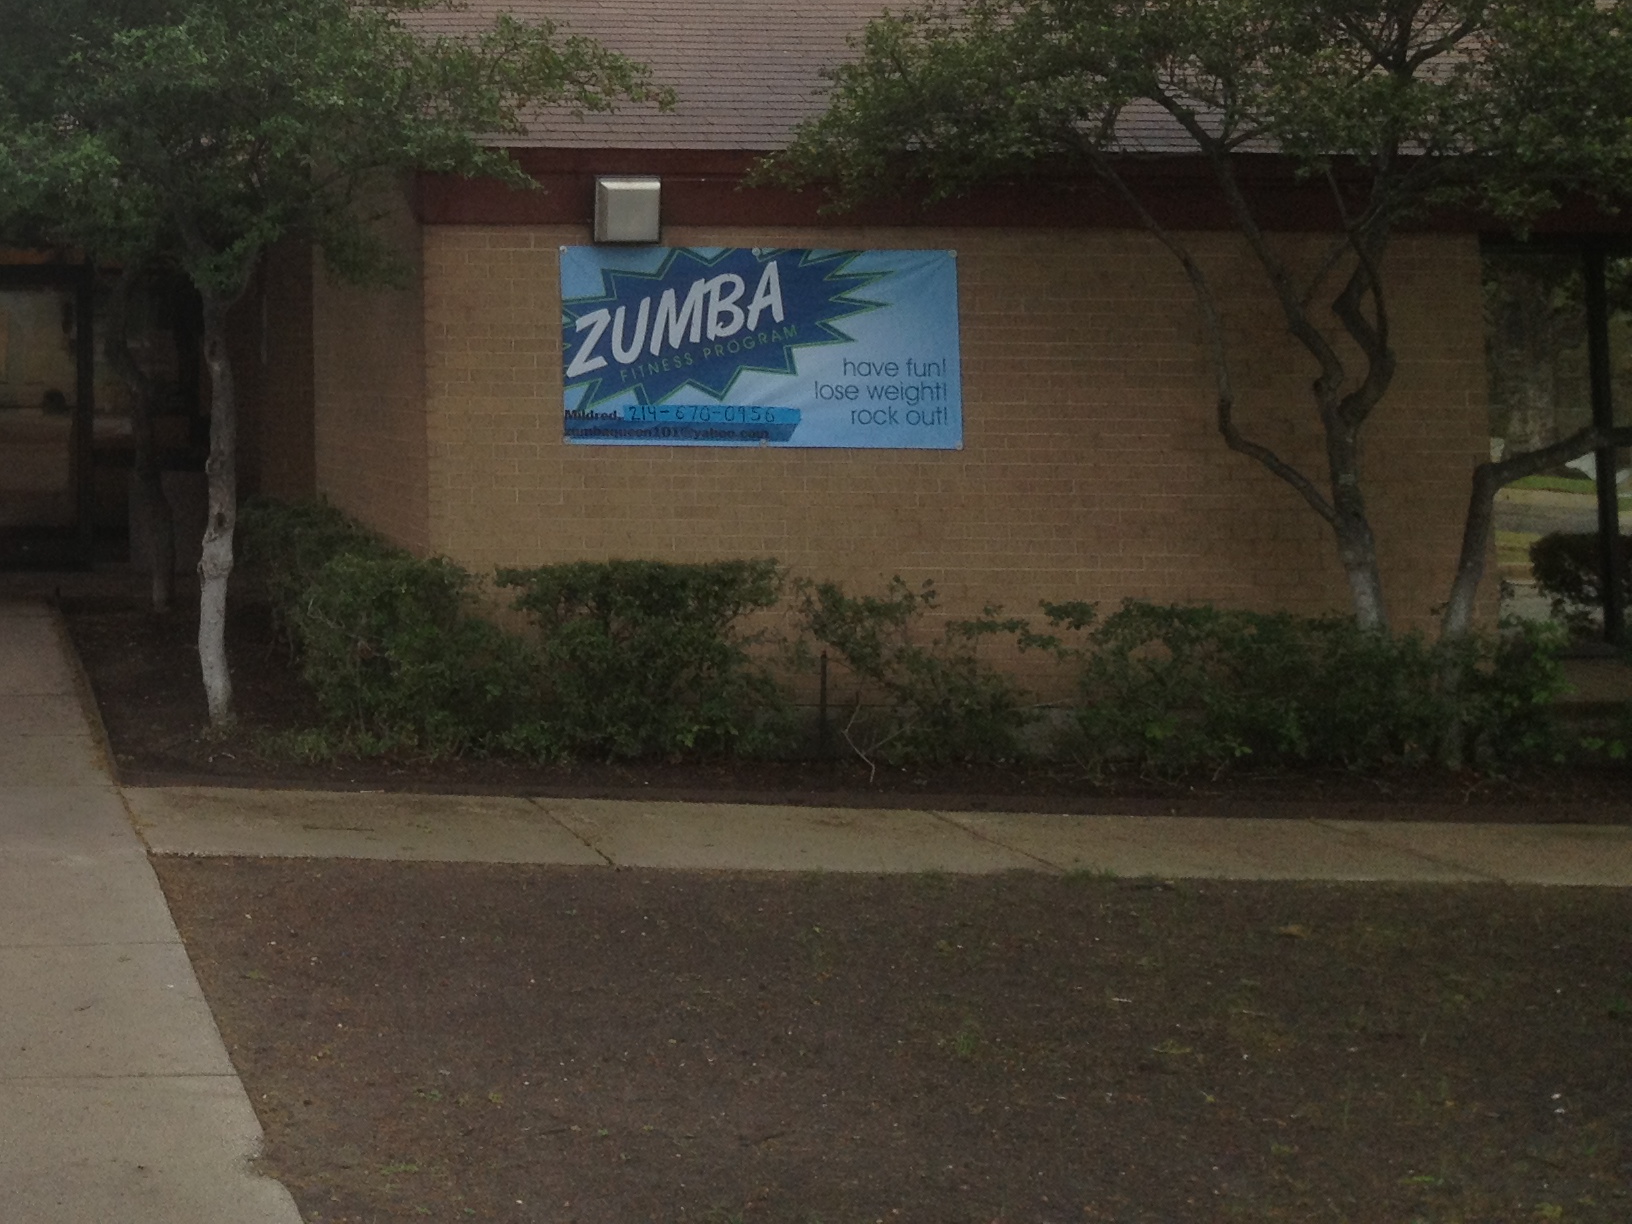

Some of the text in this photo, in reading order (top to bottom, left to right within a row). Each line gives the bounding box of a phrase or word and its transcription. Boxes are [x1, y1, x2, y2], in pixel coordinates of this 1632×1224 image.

[566, 260, 786, 378] ZUMBA
[619, 325, 799, 383] FITNESS PROGRAM
[843, 357, 947, 378] have fun!
[814, 380, 949, 406] lose weight!
[850, 405, 949, 426] rock out!
